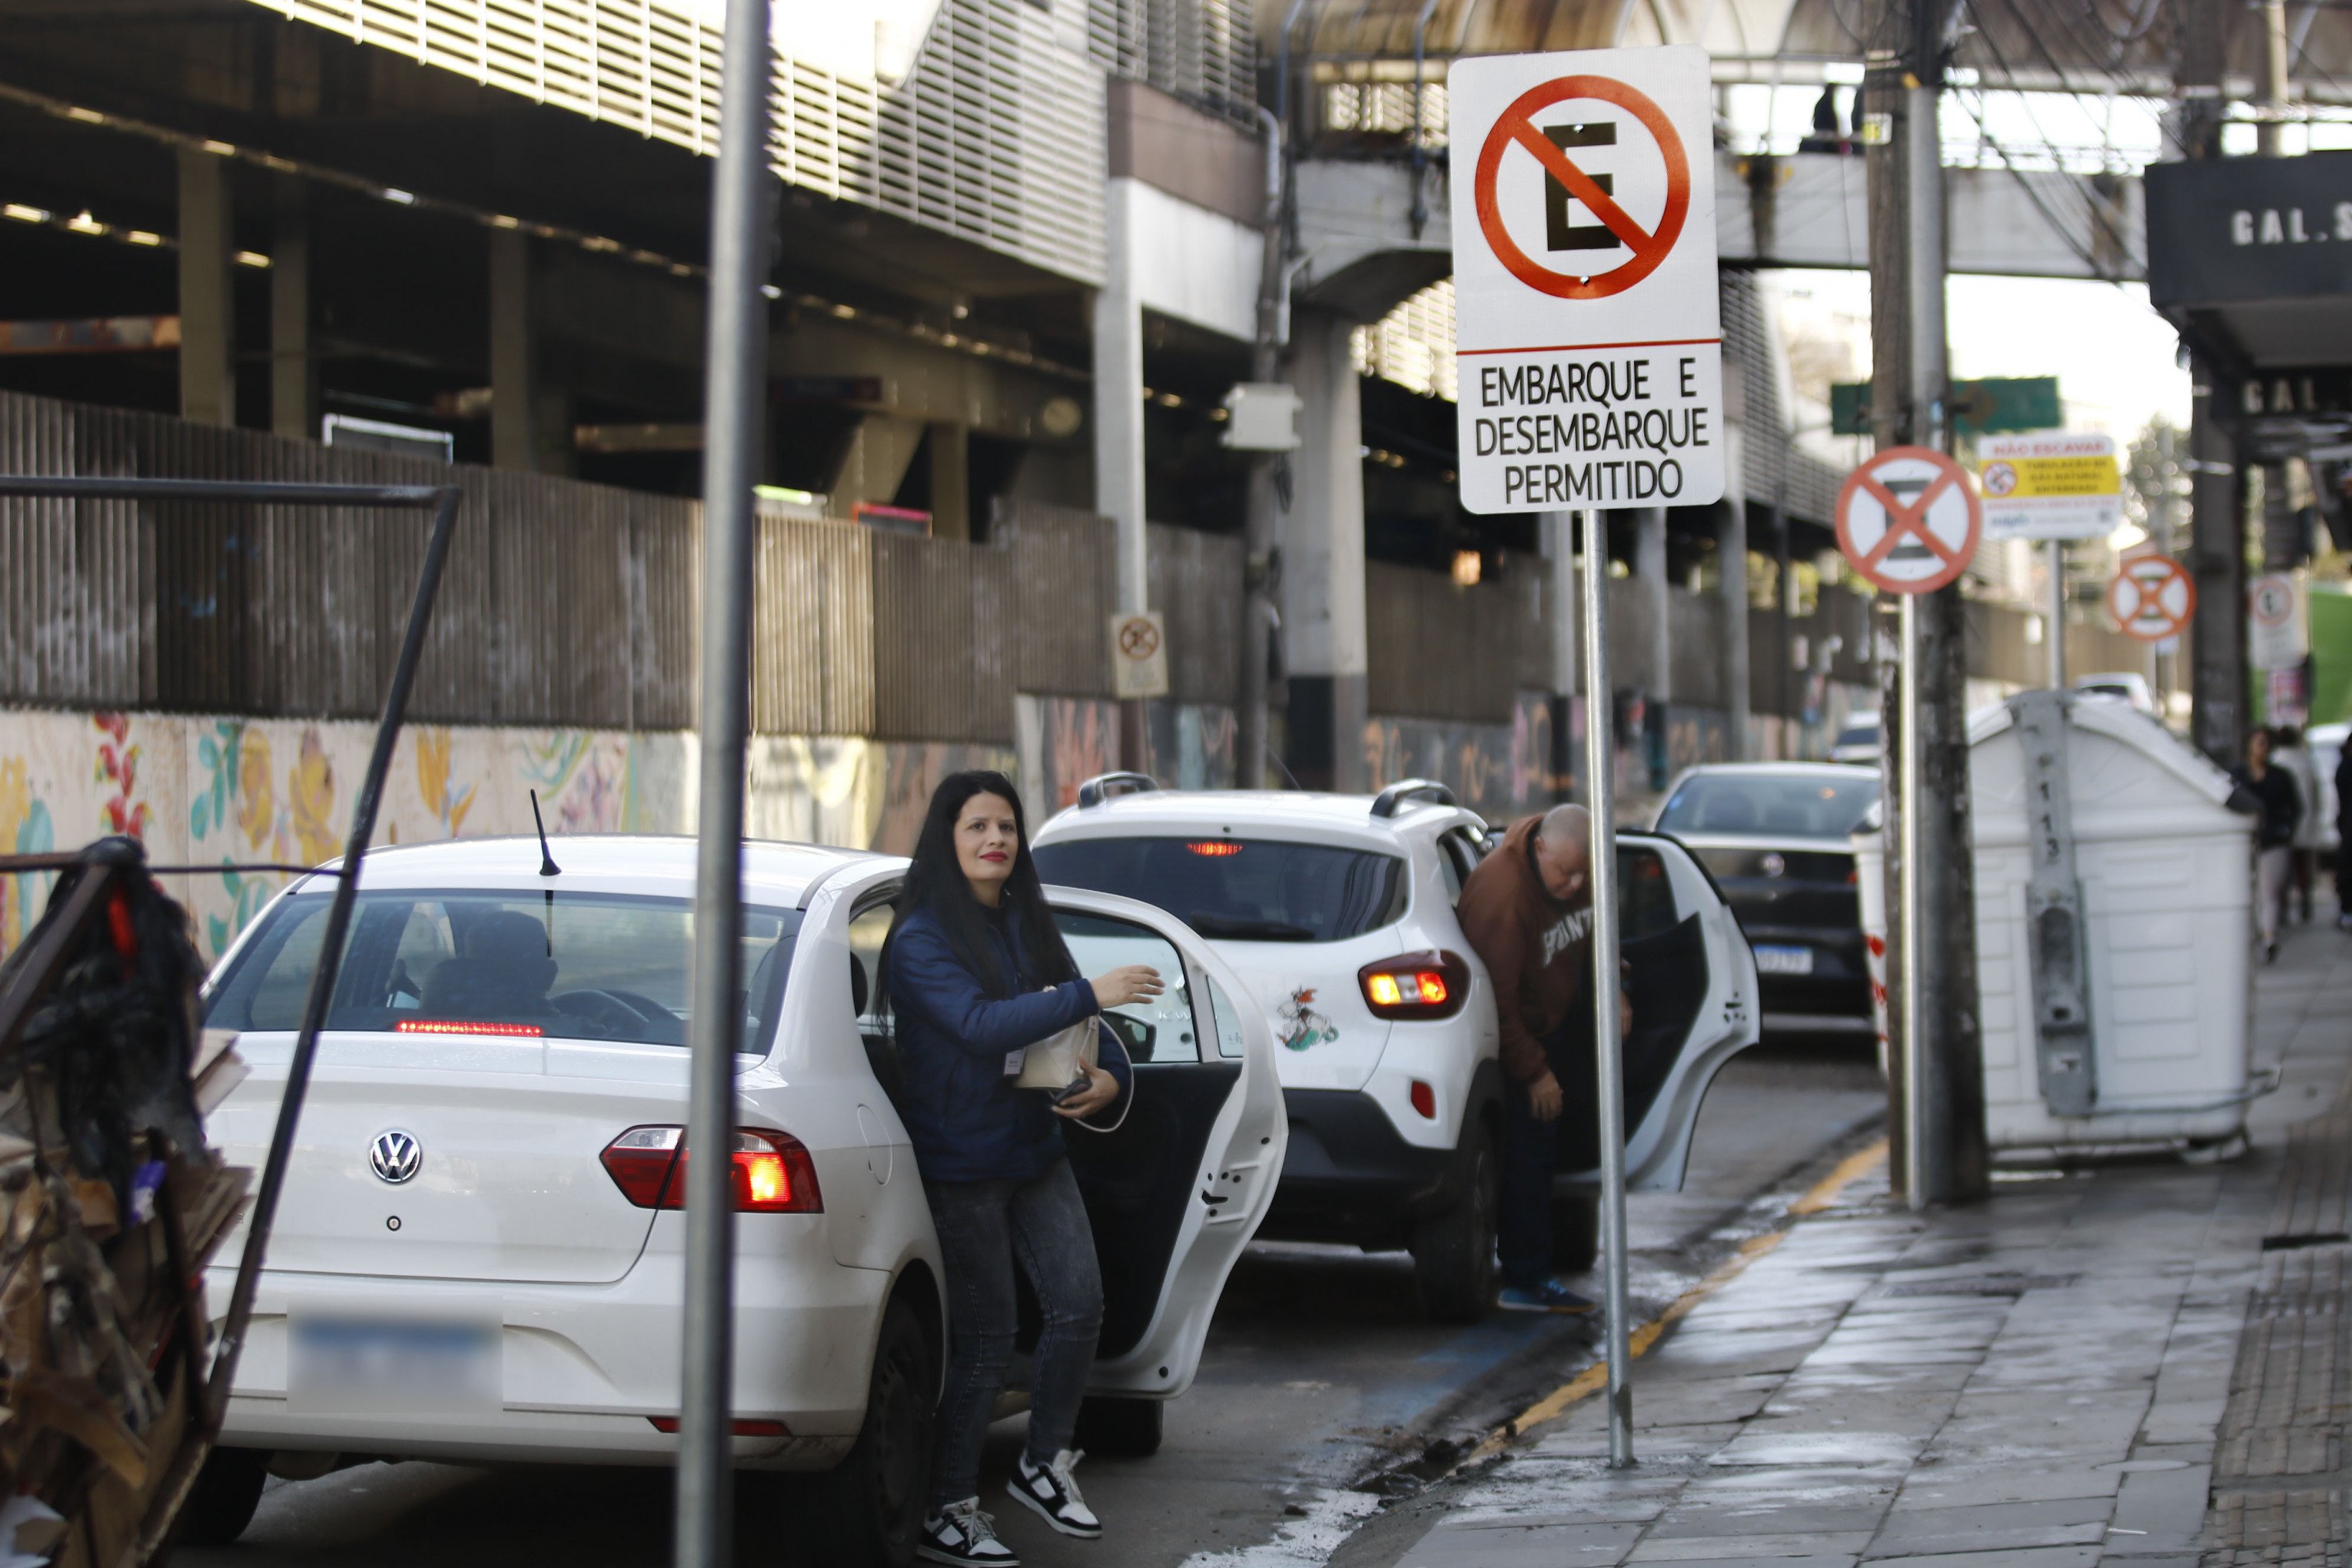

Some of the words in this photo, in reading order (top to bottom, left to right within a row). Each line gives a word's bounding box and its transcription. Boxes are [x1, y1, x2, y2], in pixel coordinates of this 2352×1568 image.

[1480, 359, 1651, 409] EMBARQUE
[1679, 357, 1697, 397] E
[1475, 407, 1709, 456] DESEMBARQUE
[1504, 457, 1683, 504] PERMITIDO
